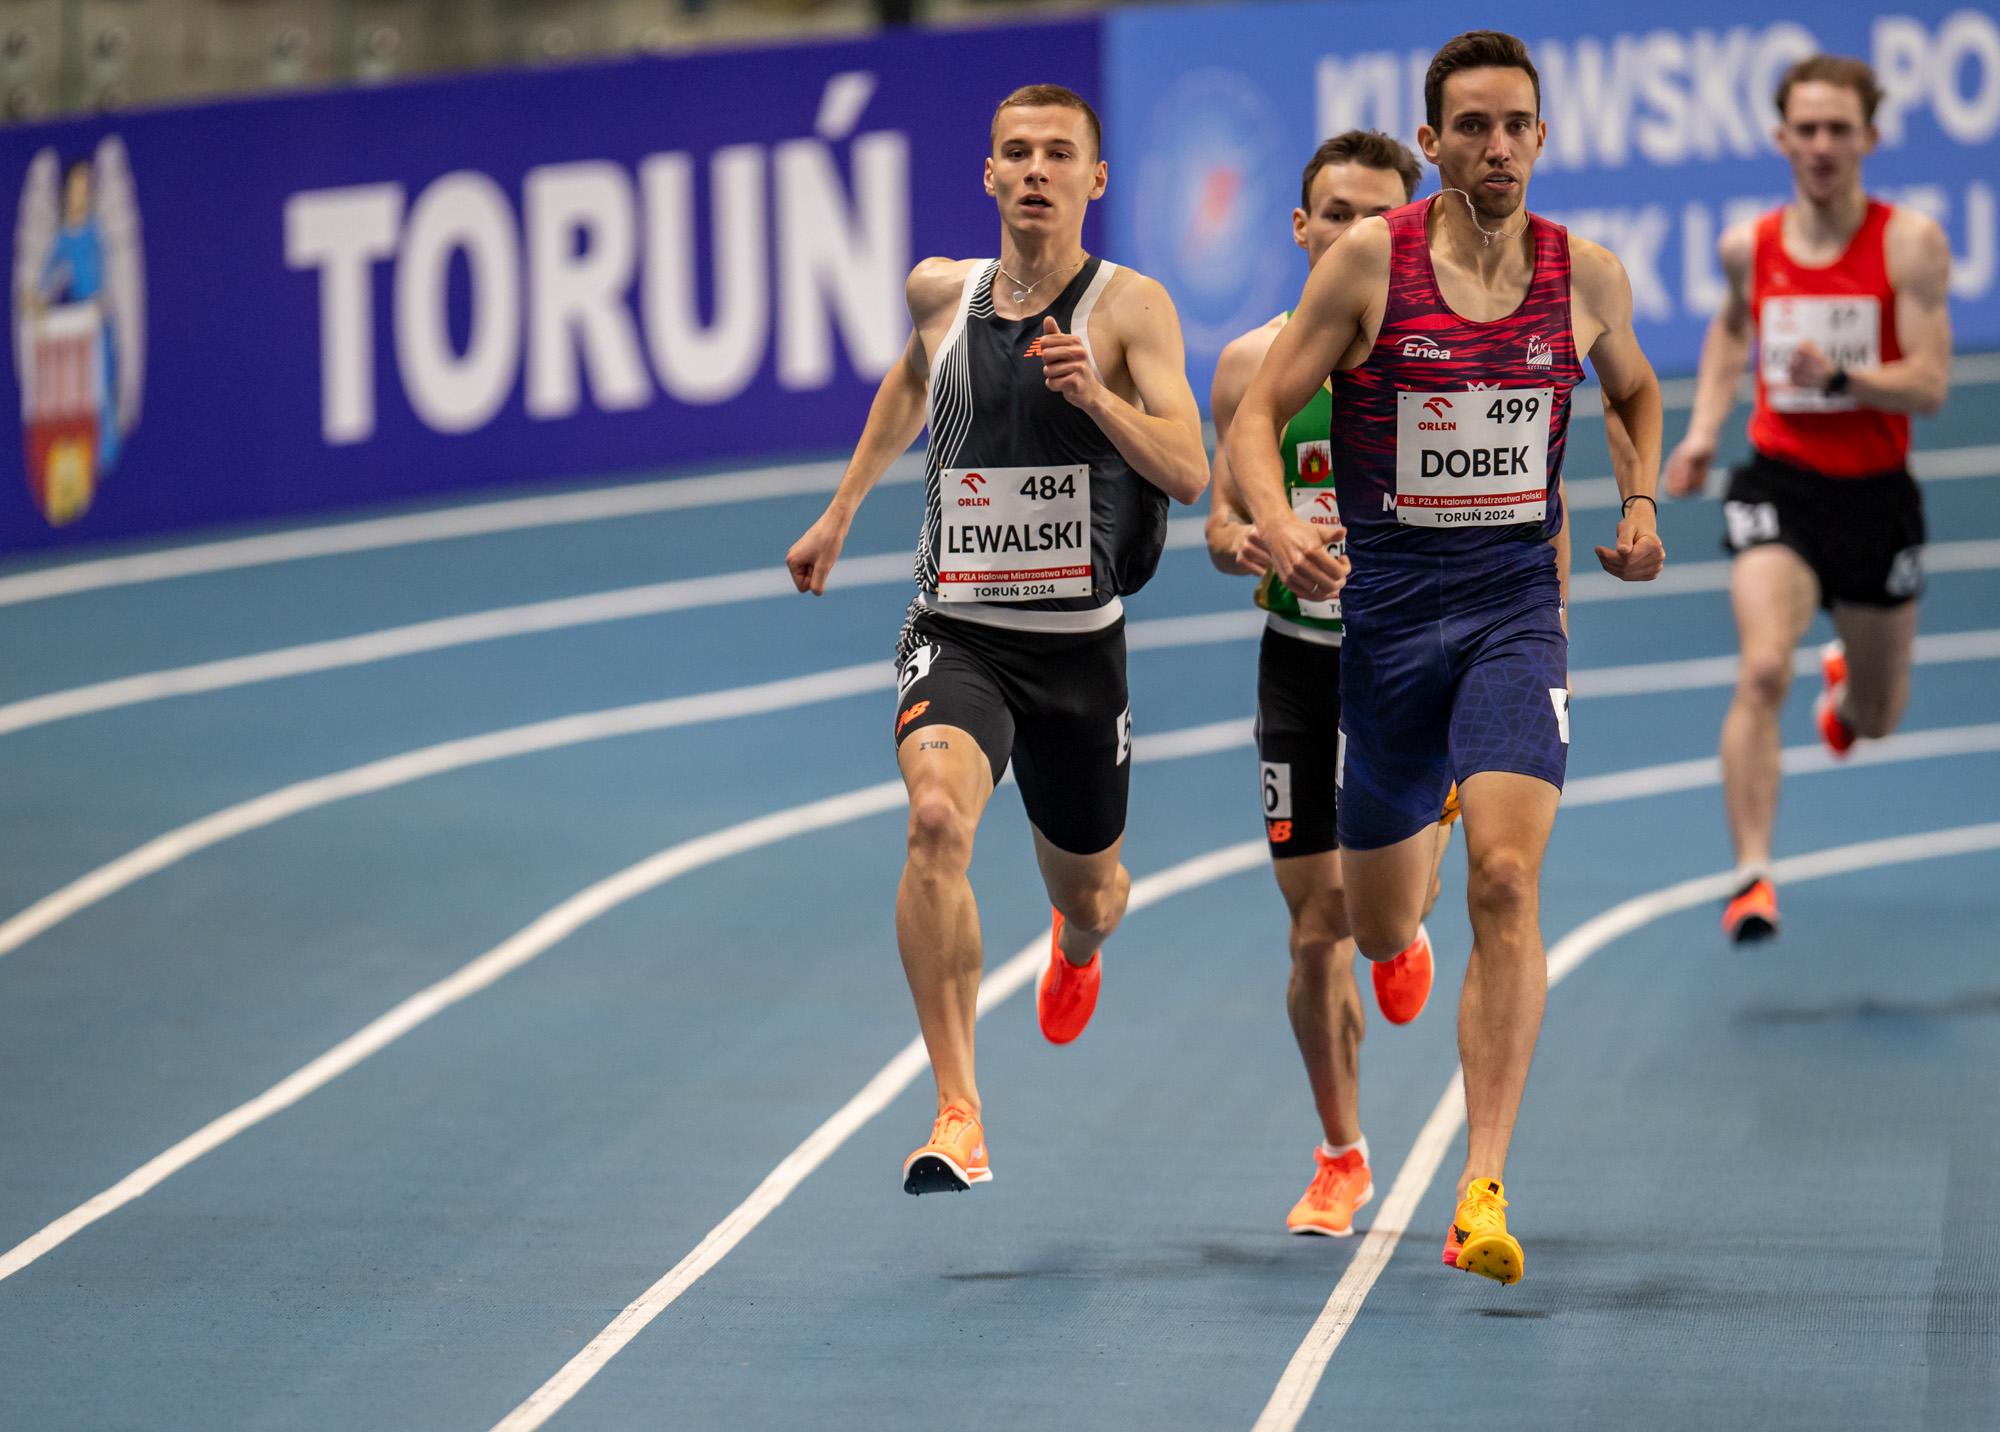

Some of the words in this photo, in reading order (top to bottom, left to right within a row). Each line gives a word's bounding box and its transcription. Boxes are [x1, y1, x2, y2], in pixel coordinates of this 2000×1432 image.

[284, 73, 911, 446] TORUŃ
[1402, 343, 1451, 360] Enea
[1486, 397, 1540, 424] 499
[1418, 422, 1457, 431] ORLEN
[1421, 445, 1529, 478] DOBEK
[1020, 474, 1076, 500] 484
[957, 498, 990, 507] ORLEN
[1404, 497, 1417, 505] 68.
[1419, 498, 1439, 506] PZLA
[1440, 497, 1472, 506] Halowe
[1474, 495, 1520, 505] Mistrzostwa
[1521, 491, 1542, 501] Polski
[1435, 509, 1482, 522] TORUŃ
[1484, 509, 1515, 521] 2024
[948, 521, 1082, 554] LEWALSKI
[945, 574, 958, 582] 68.
[958, 573, 977, 581] PZLA
[977, 573, 1009, 581] Halowe
[1010, 569, 1061, 580] Mistrzostwa
[1062, 567, 1086, 577] Polski
[973, 584, 1020, 597] TORUŃ
[1023, 584, 1055, 596] 2024
[919, 739, 949, 751] run
[1264, 768, 1278, 812] 6
